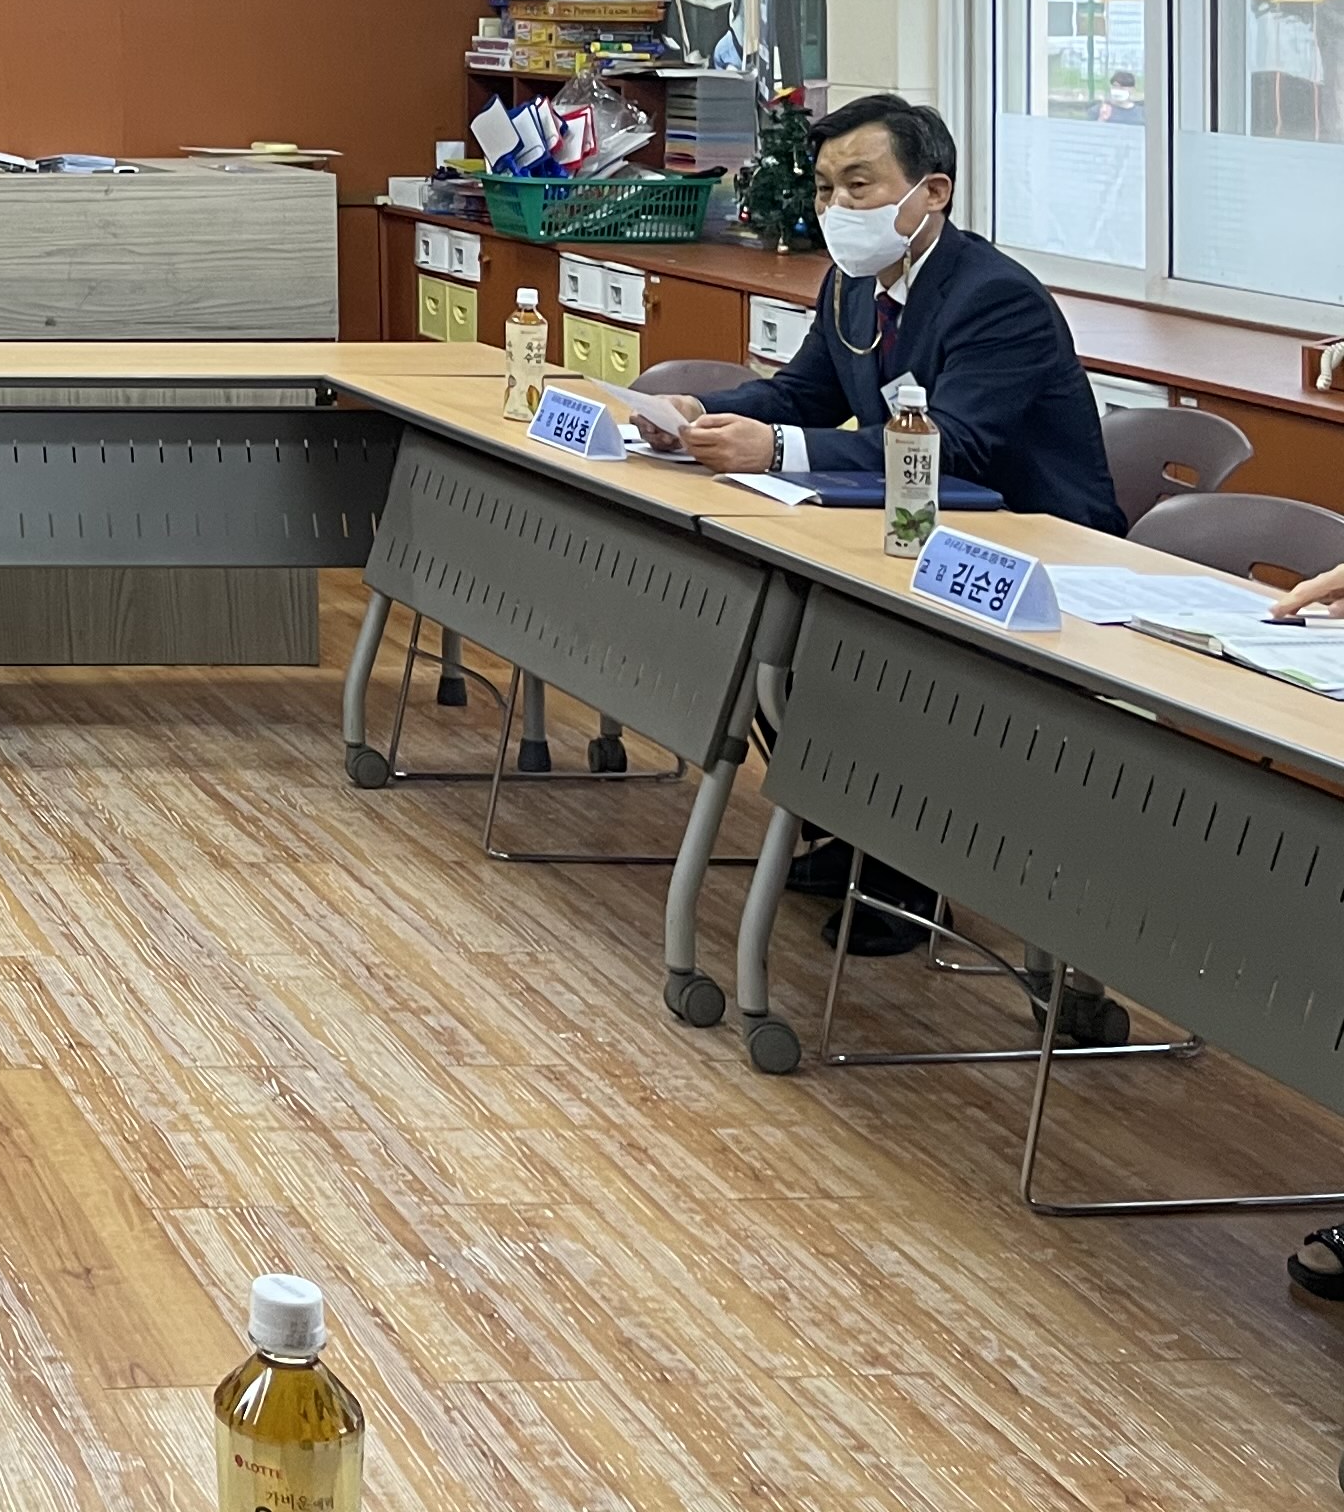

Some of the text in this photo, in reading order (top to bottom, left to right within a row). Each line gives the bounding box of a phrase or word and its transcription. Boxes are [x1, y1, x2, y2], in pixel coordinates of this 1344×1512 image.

[903, 454, 932, 470] 아침
[903, 469, 932, 486] 헛개
[949, 562, 1015, 612] 김순영
